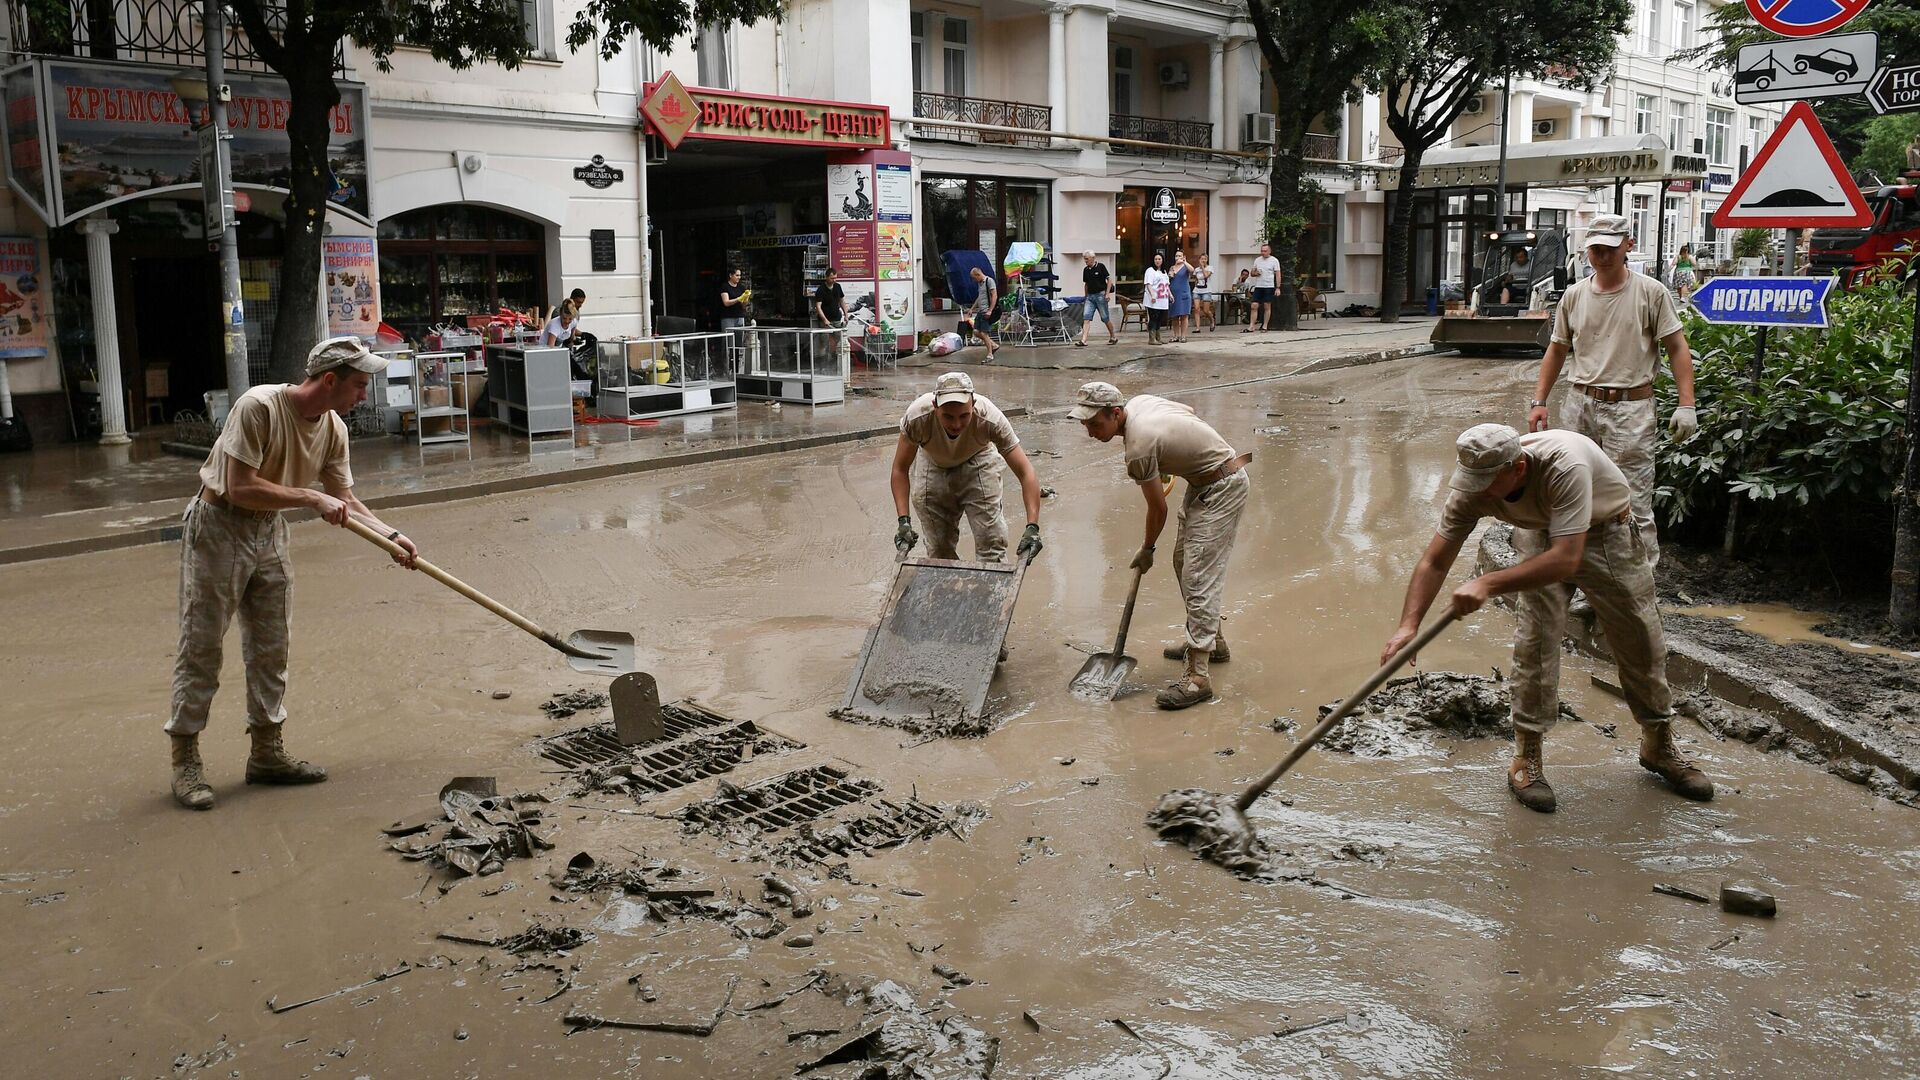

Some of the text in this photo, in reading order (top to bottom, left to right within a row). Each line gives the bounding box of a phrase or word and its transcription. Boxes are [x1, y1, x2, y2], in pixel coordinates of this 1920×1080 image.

[226, 96, 353, 135] СУВЕЫ
[323, 241, 373, 254] ЫМСКИЕ
[323, 255, 372, 267] ВЕНИРЫ
[1711, 288, 1814, 313] НОТАРИУС
